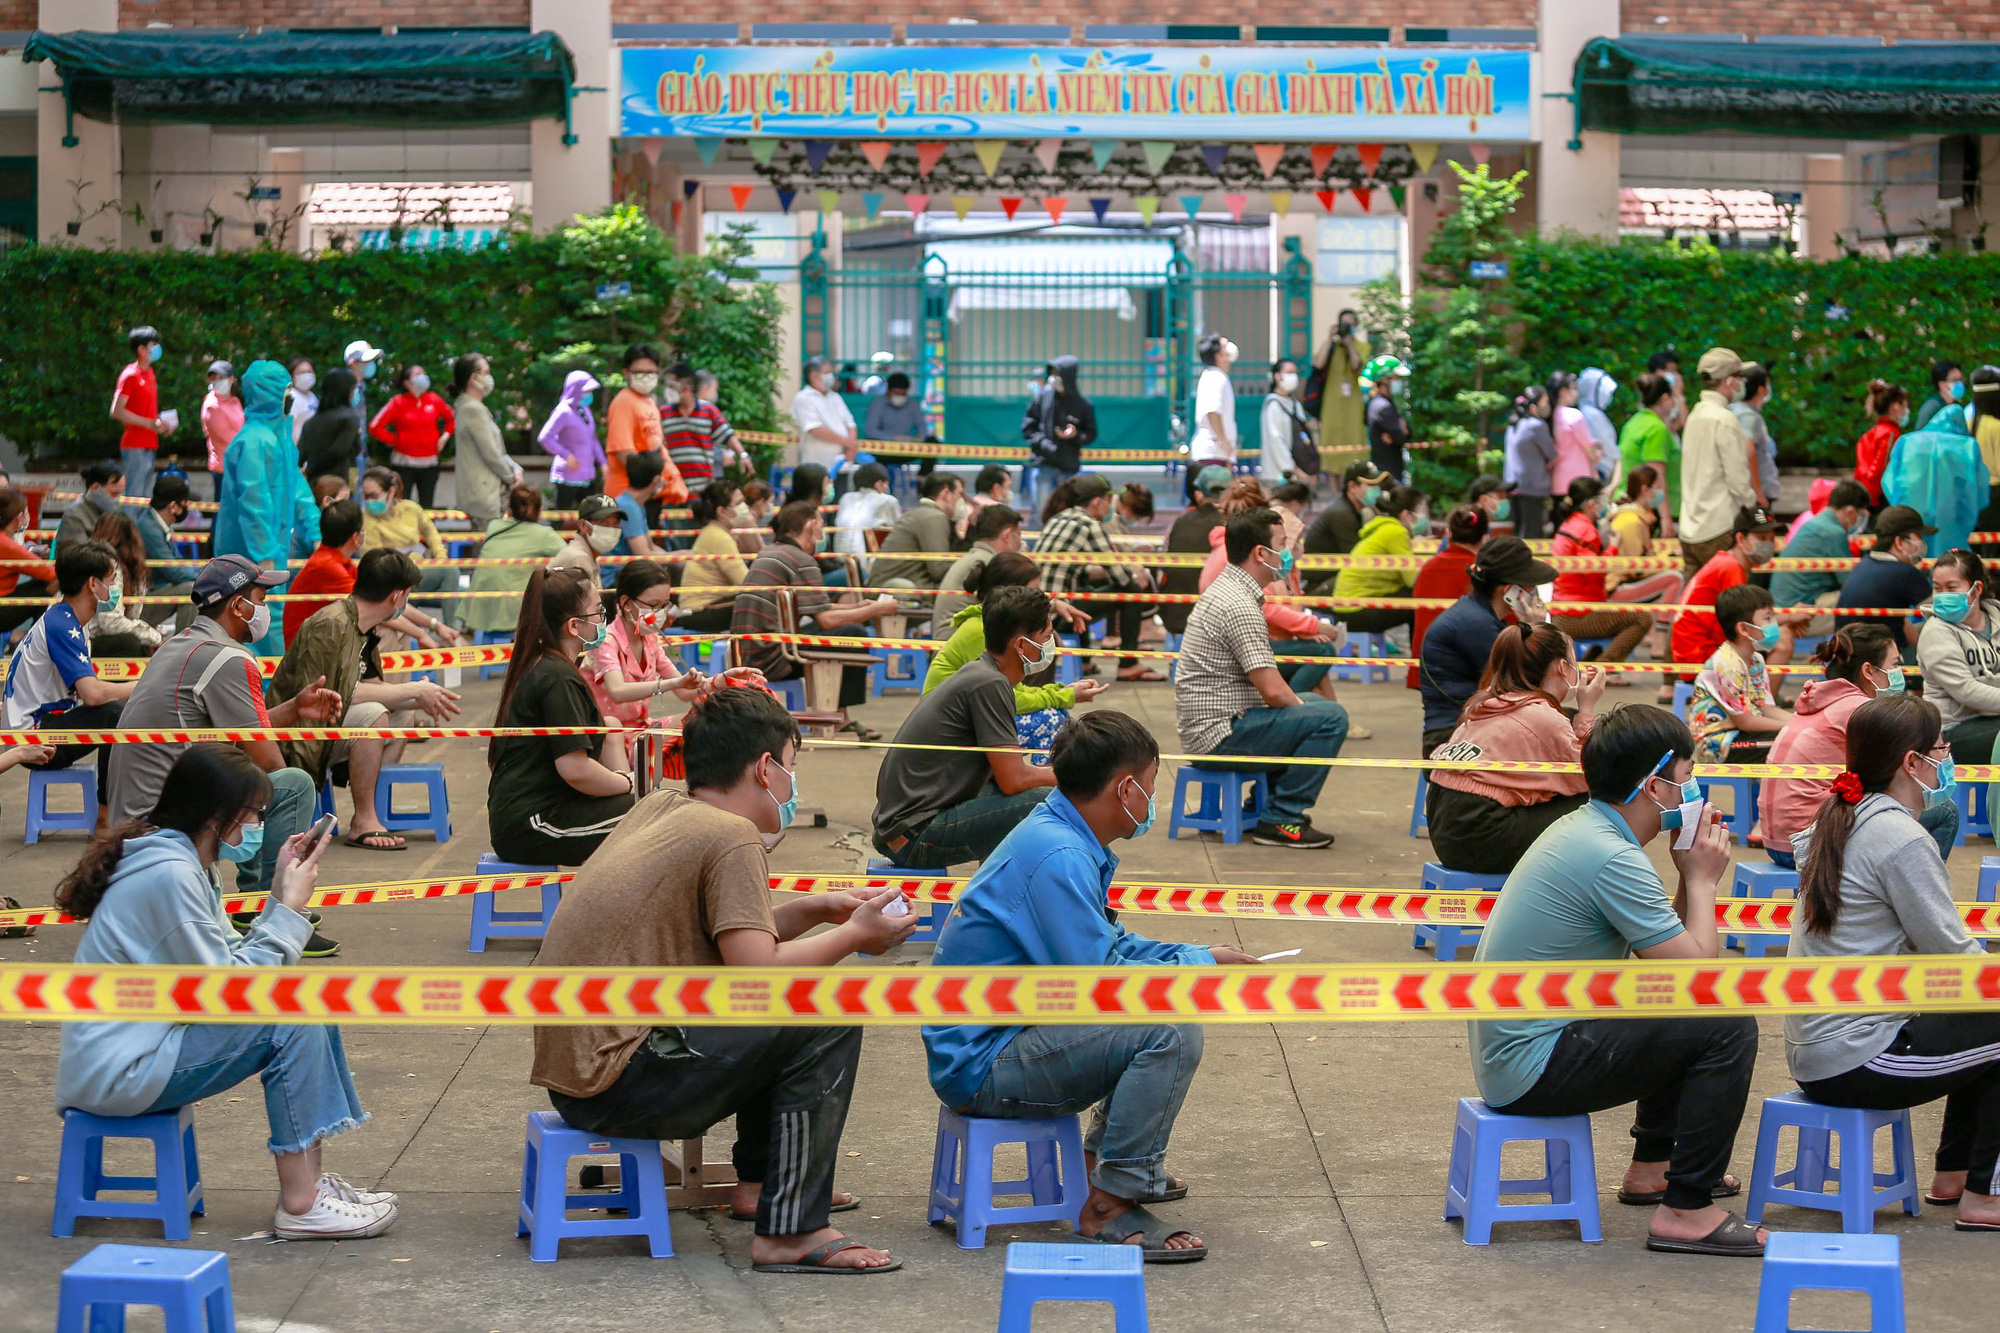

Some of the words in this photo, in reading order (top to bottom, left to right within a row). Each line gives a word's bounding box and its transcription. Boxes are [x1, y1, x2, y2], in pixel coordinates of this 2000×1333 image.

[658, 55, 723, 114] GIÁO
[727, 71, 782, 132] DỤC
[786, 51, 847, 115] TIỂU
[852, 71, 909, 132] HỌC
[911, 70, 1010, 115] TP.HCM
[1016, 54, 1051, 115] LÀ
[1057, 50, 1123, 115] NIỀM
[1126, 71, 1172, 115] TIN
[1177, 54, 1229, 115] CỦA
[1233, 70, 1283, 115] GIA
[1287, 57, 1356, 115] ĐÌNH
[1360, 57, 1394, 115] VÀ
[1443, 58, 1495, 133] HỘI
